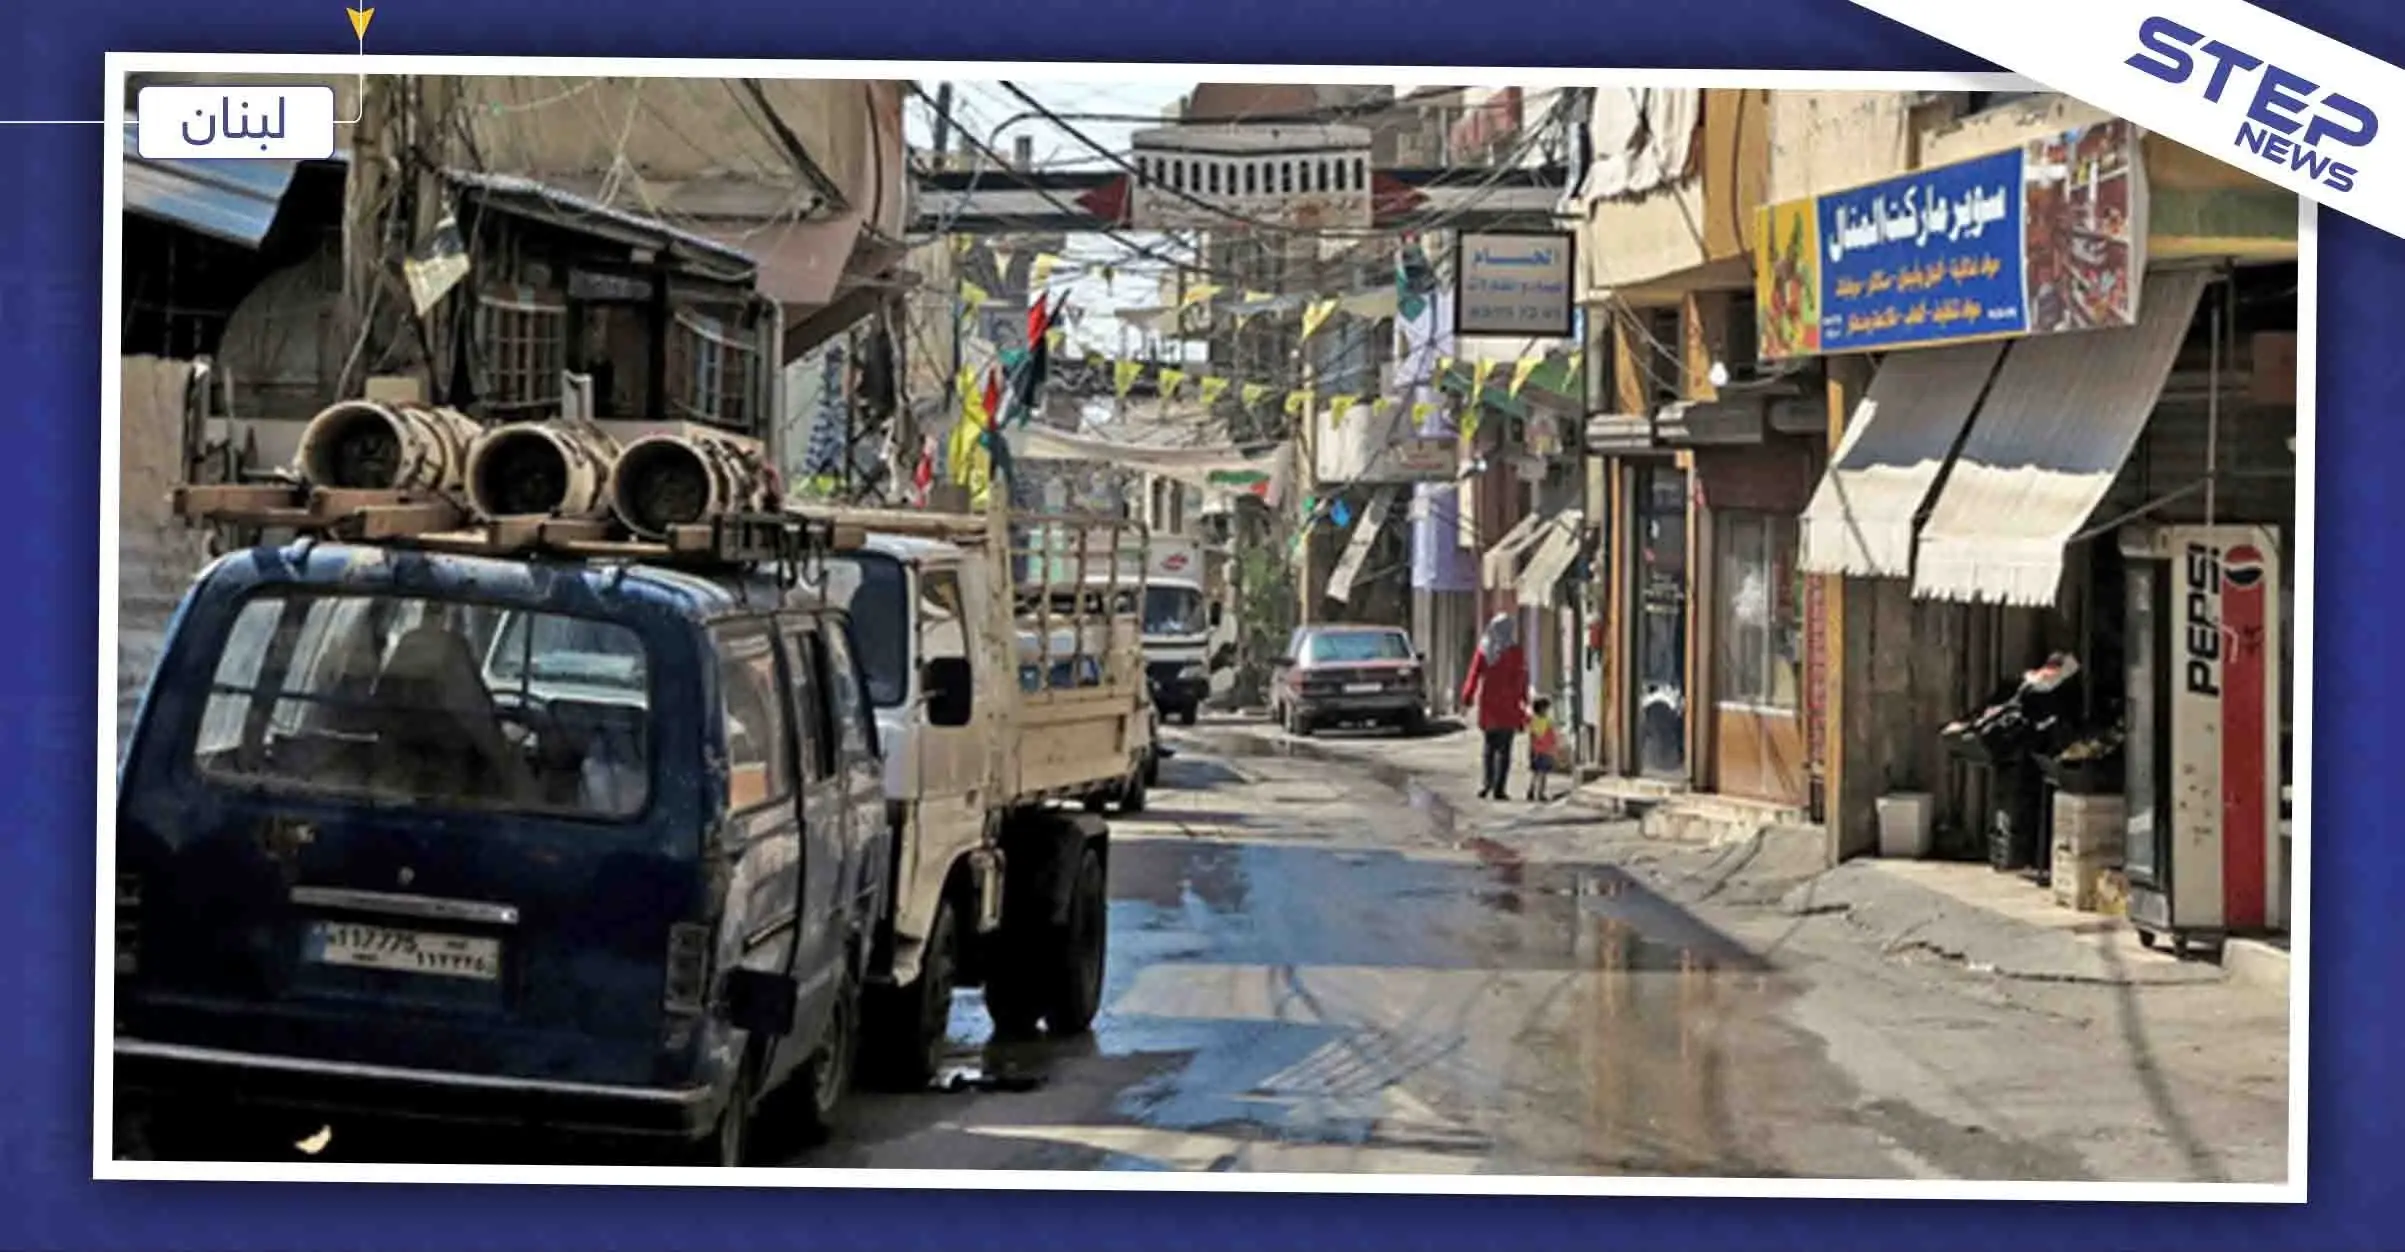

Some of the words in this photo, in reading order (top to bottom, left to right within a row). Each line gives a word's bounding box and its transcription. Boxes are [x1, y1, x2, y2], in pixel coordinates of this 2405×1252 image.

[1883, 184, 1948, 248] ماركت
[1949, 184, 2007, 242] سوبر
[2187, 540, 2220, 698] PEPSI
